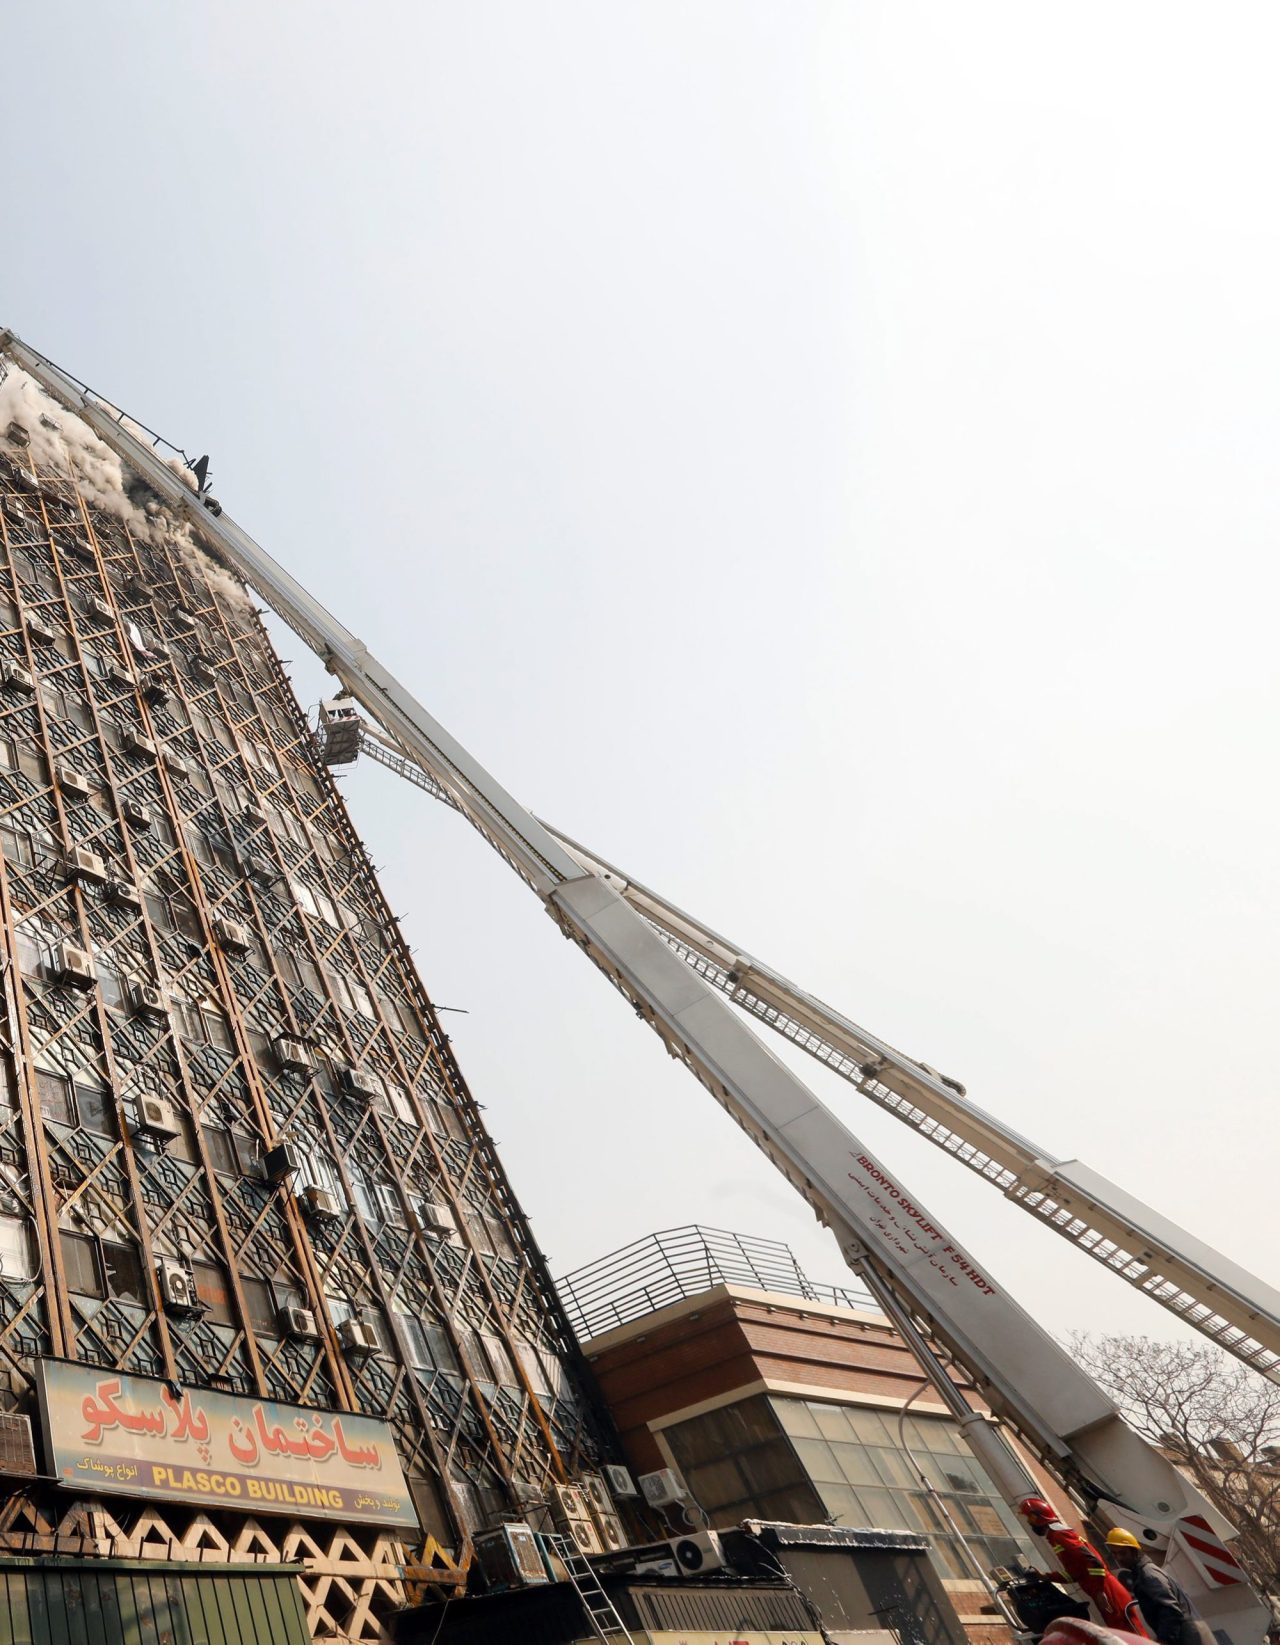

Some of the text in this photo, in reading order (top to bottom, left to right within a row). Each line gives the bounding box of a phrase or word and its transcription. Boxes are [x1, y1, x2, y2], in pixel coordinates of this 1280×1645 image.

[856, 1155, 900, 1199] BRONTO
[897, 1198, 943, 1240] SKYLIFT
[80, 1380, 380, 1467] ساختمان پلاسکو
[76, 1457, 138, 1480] انواع پوشاک
[152, 1465, 344, 1508] PLASCO BUILDING
[353, 1493, 375, 1510] پخش
[382, 1496, 401, 1513] تولید
